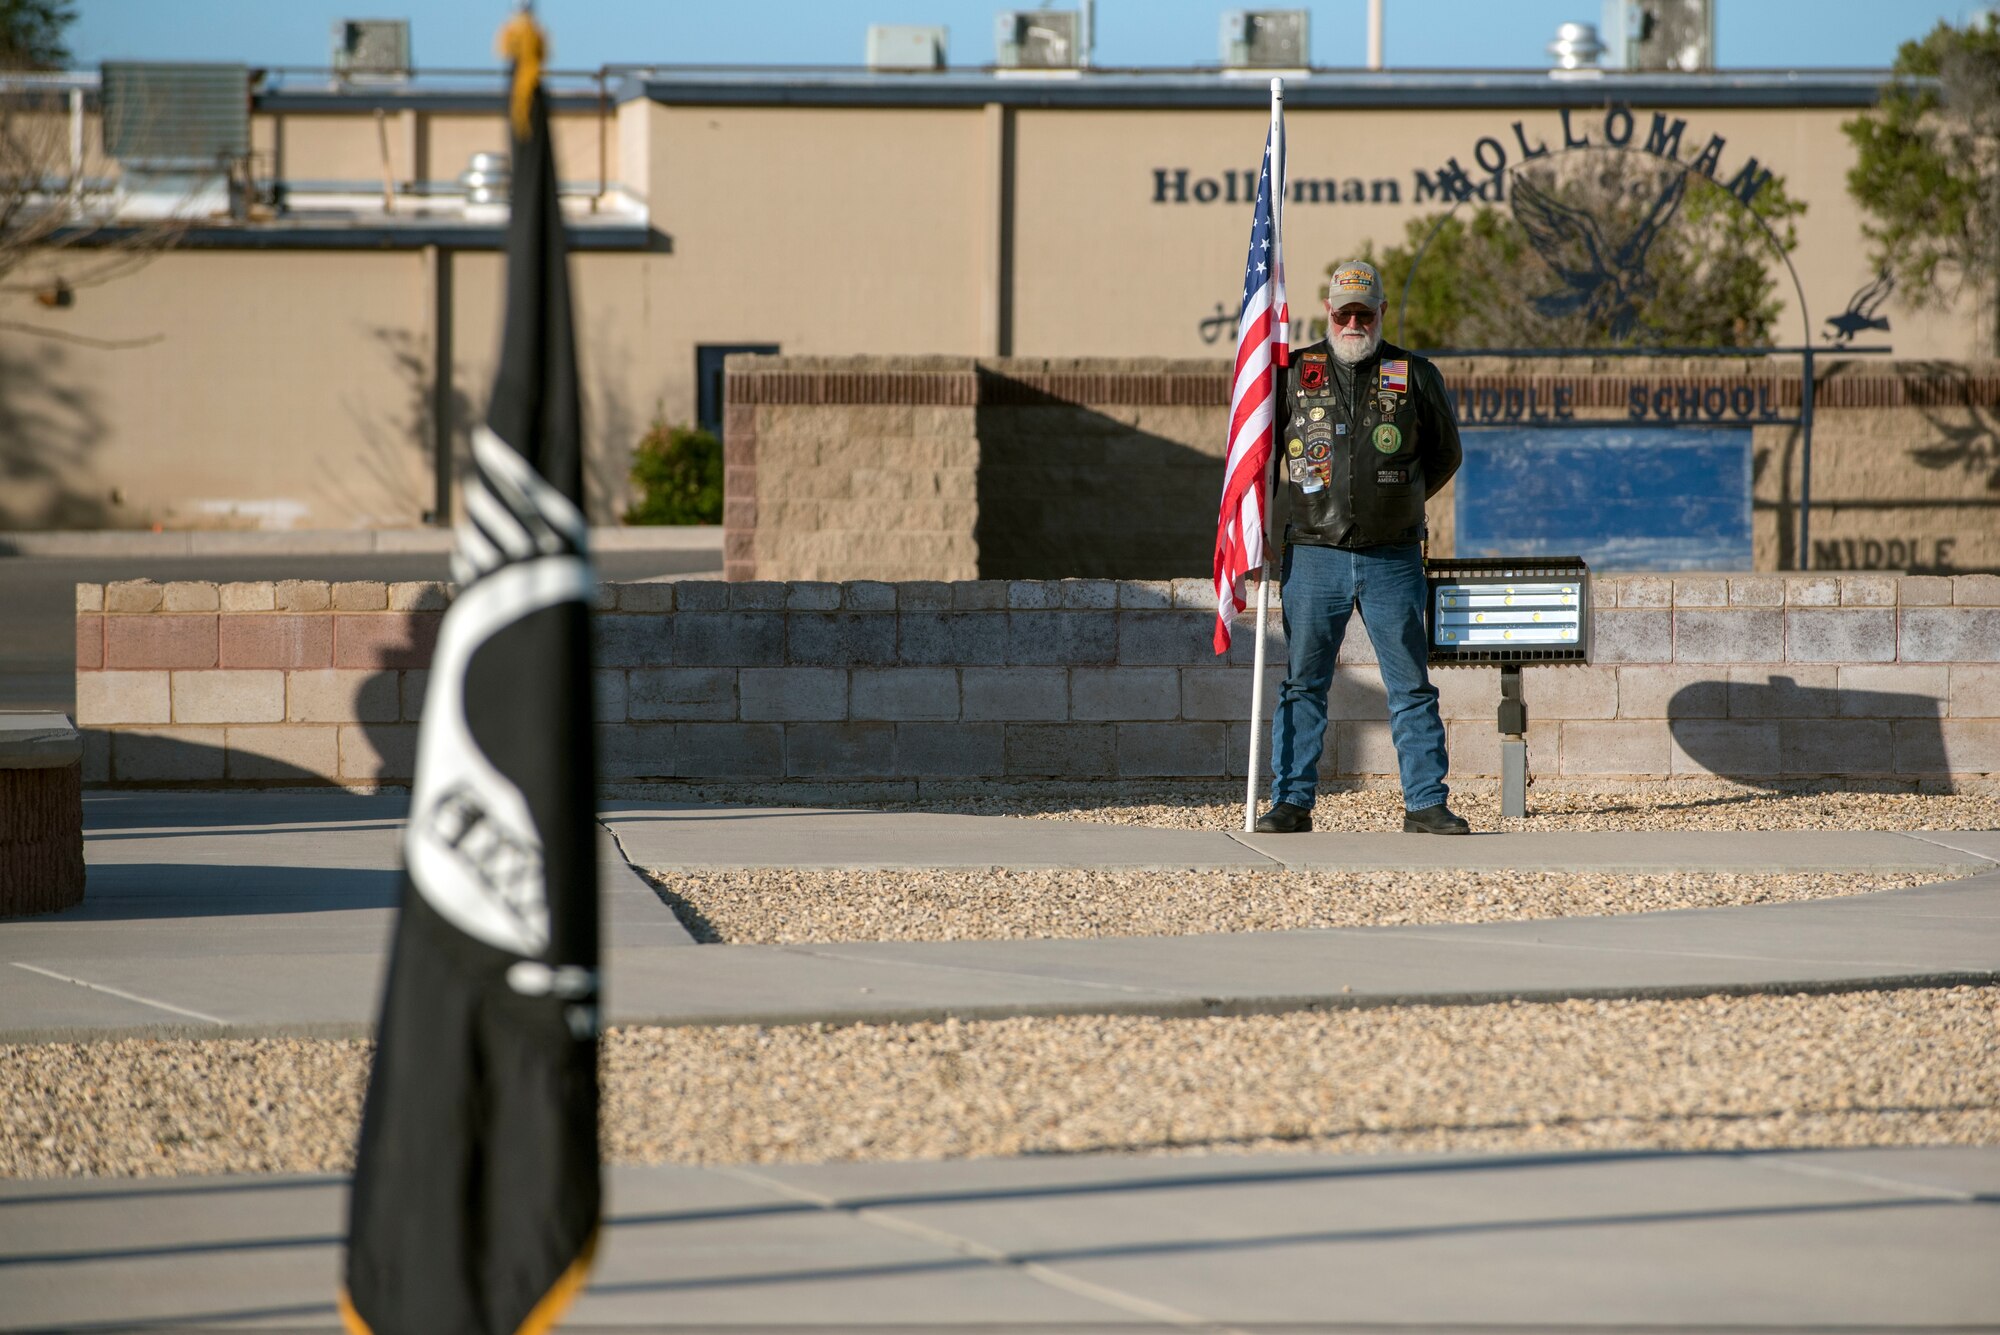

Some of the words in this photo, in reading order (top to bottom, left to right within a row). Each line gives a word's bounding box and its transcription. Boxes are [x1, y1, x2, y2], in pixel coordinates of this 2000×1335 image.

[1435, 107, 1774, 206] HOLLOMAN
[1152, 168, 1400, 203] Hollman
[1627, 386, 1779, 421] SCHOOL
